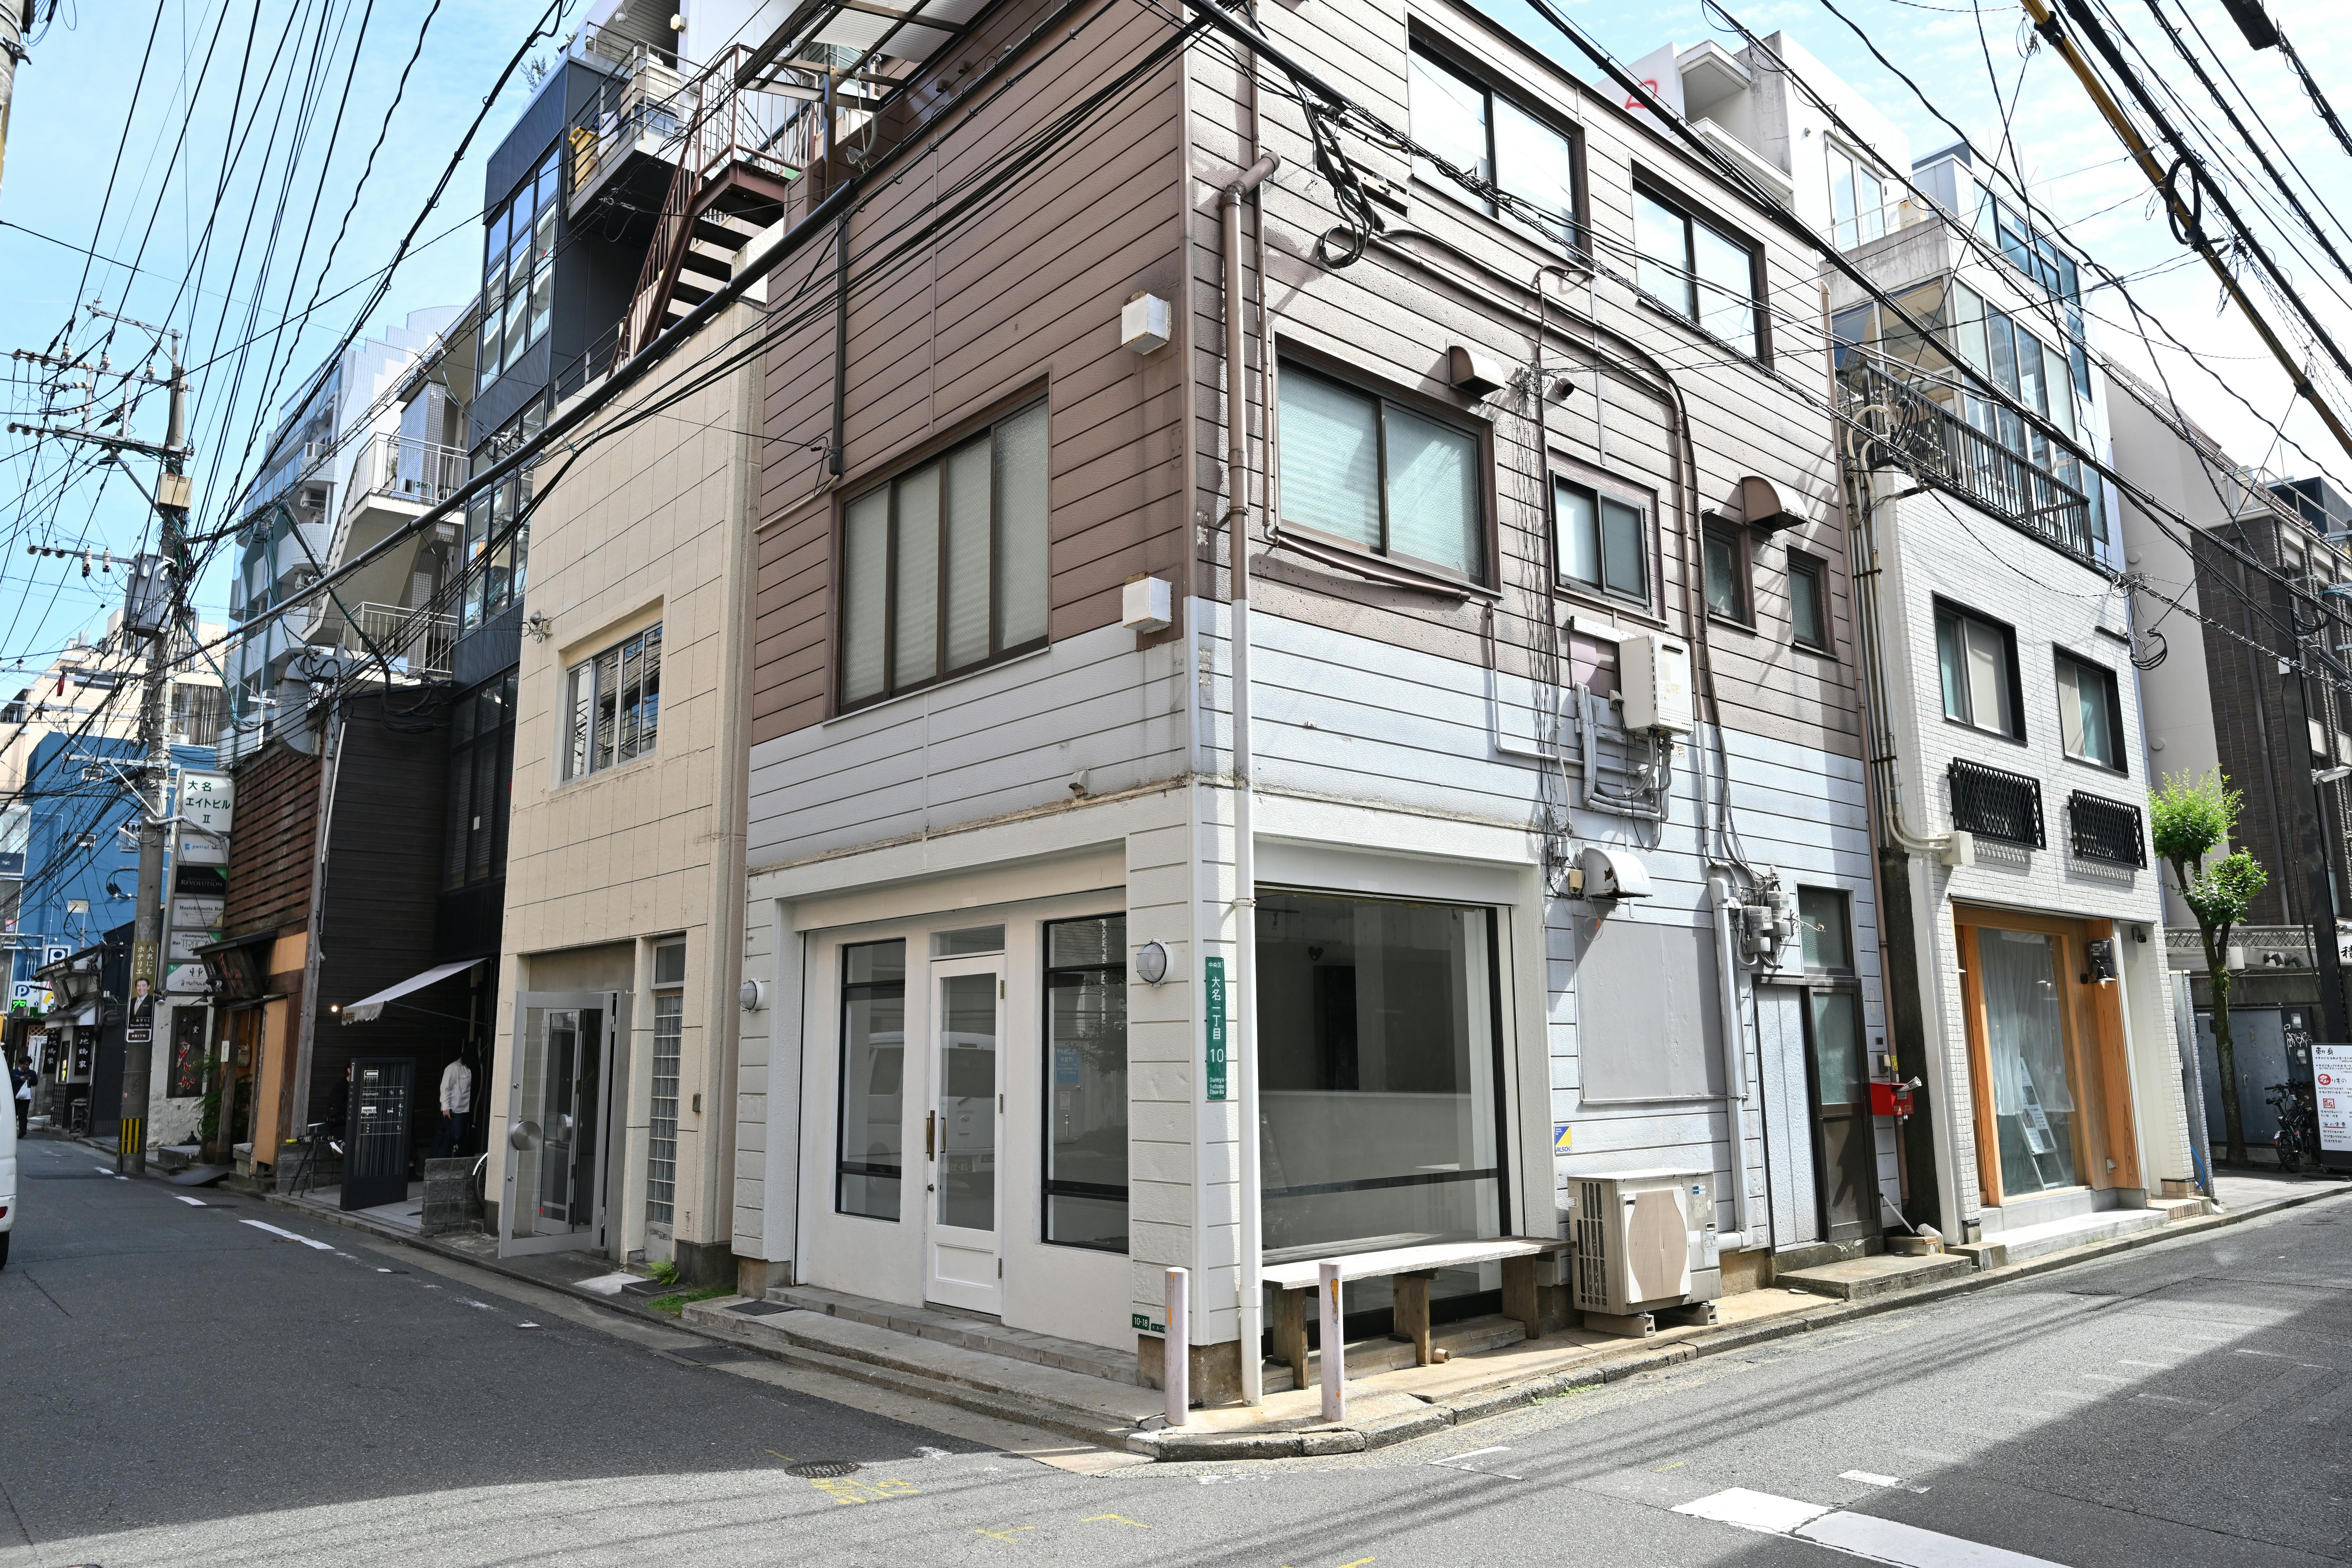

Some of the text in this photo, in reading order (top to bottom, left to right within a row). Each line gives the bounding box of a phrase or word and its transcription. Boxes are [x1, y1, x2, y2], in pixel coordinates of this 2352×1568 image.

[187, 781, 212, 792] 大名
[185, 798, 230, 809] エイトビル
[136, 945, 144, 975] ホテリエ
[1211, 976, 1221, 1040] 大名一丁目
[1210, 1048, 1224, 1063] 10
[2316, 1046, 2333, 1055] 刺身
[1134, 1317, 1148, 1327] 10-18
